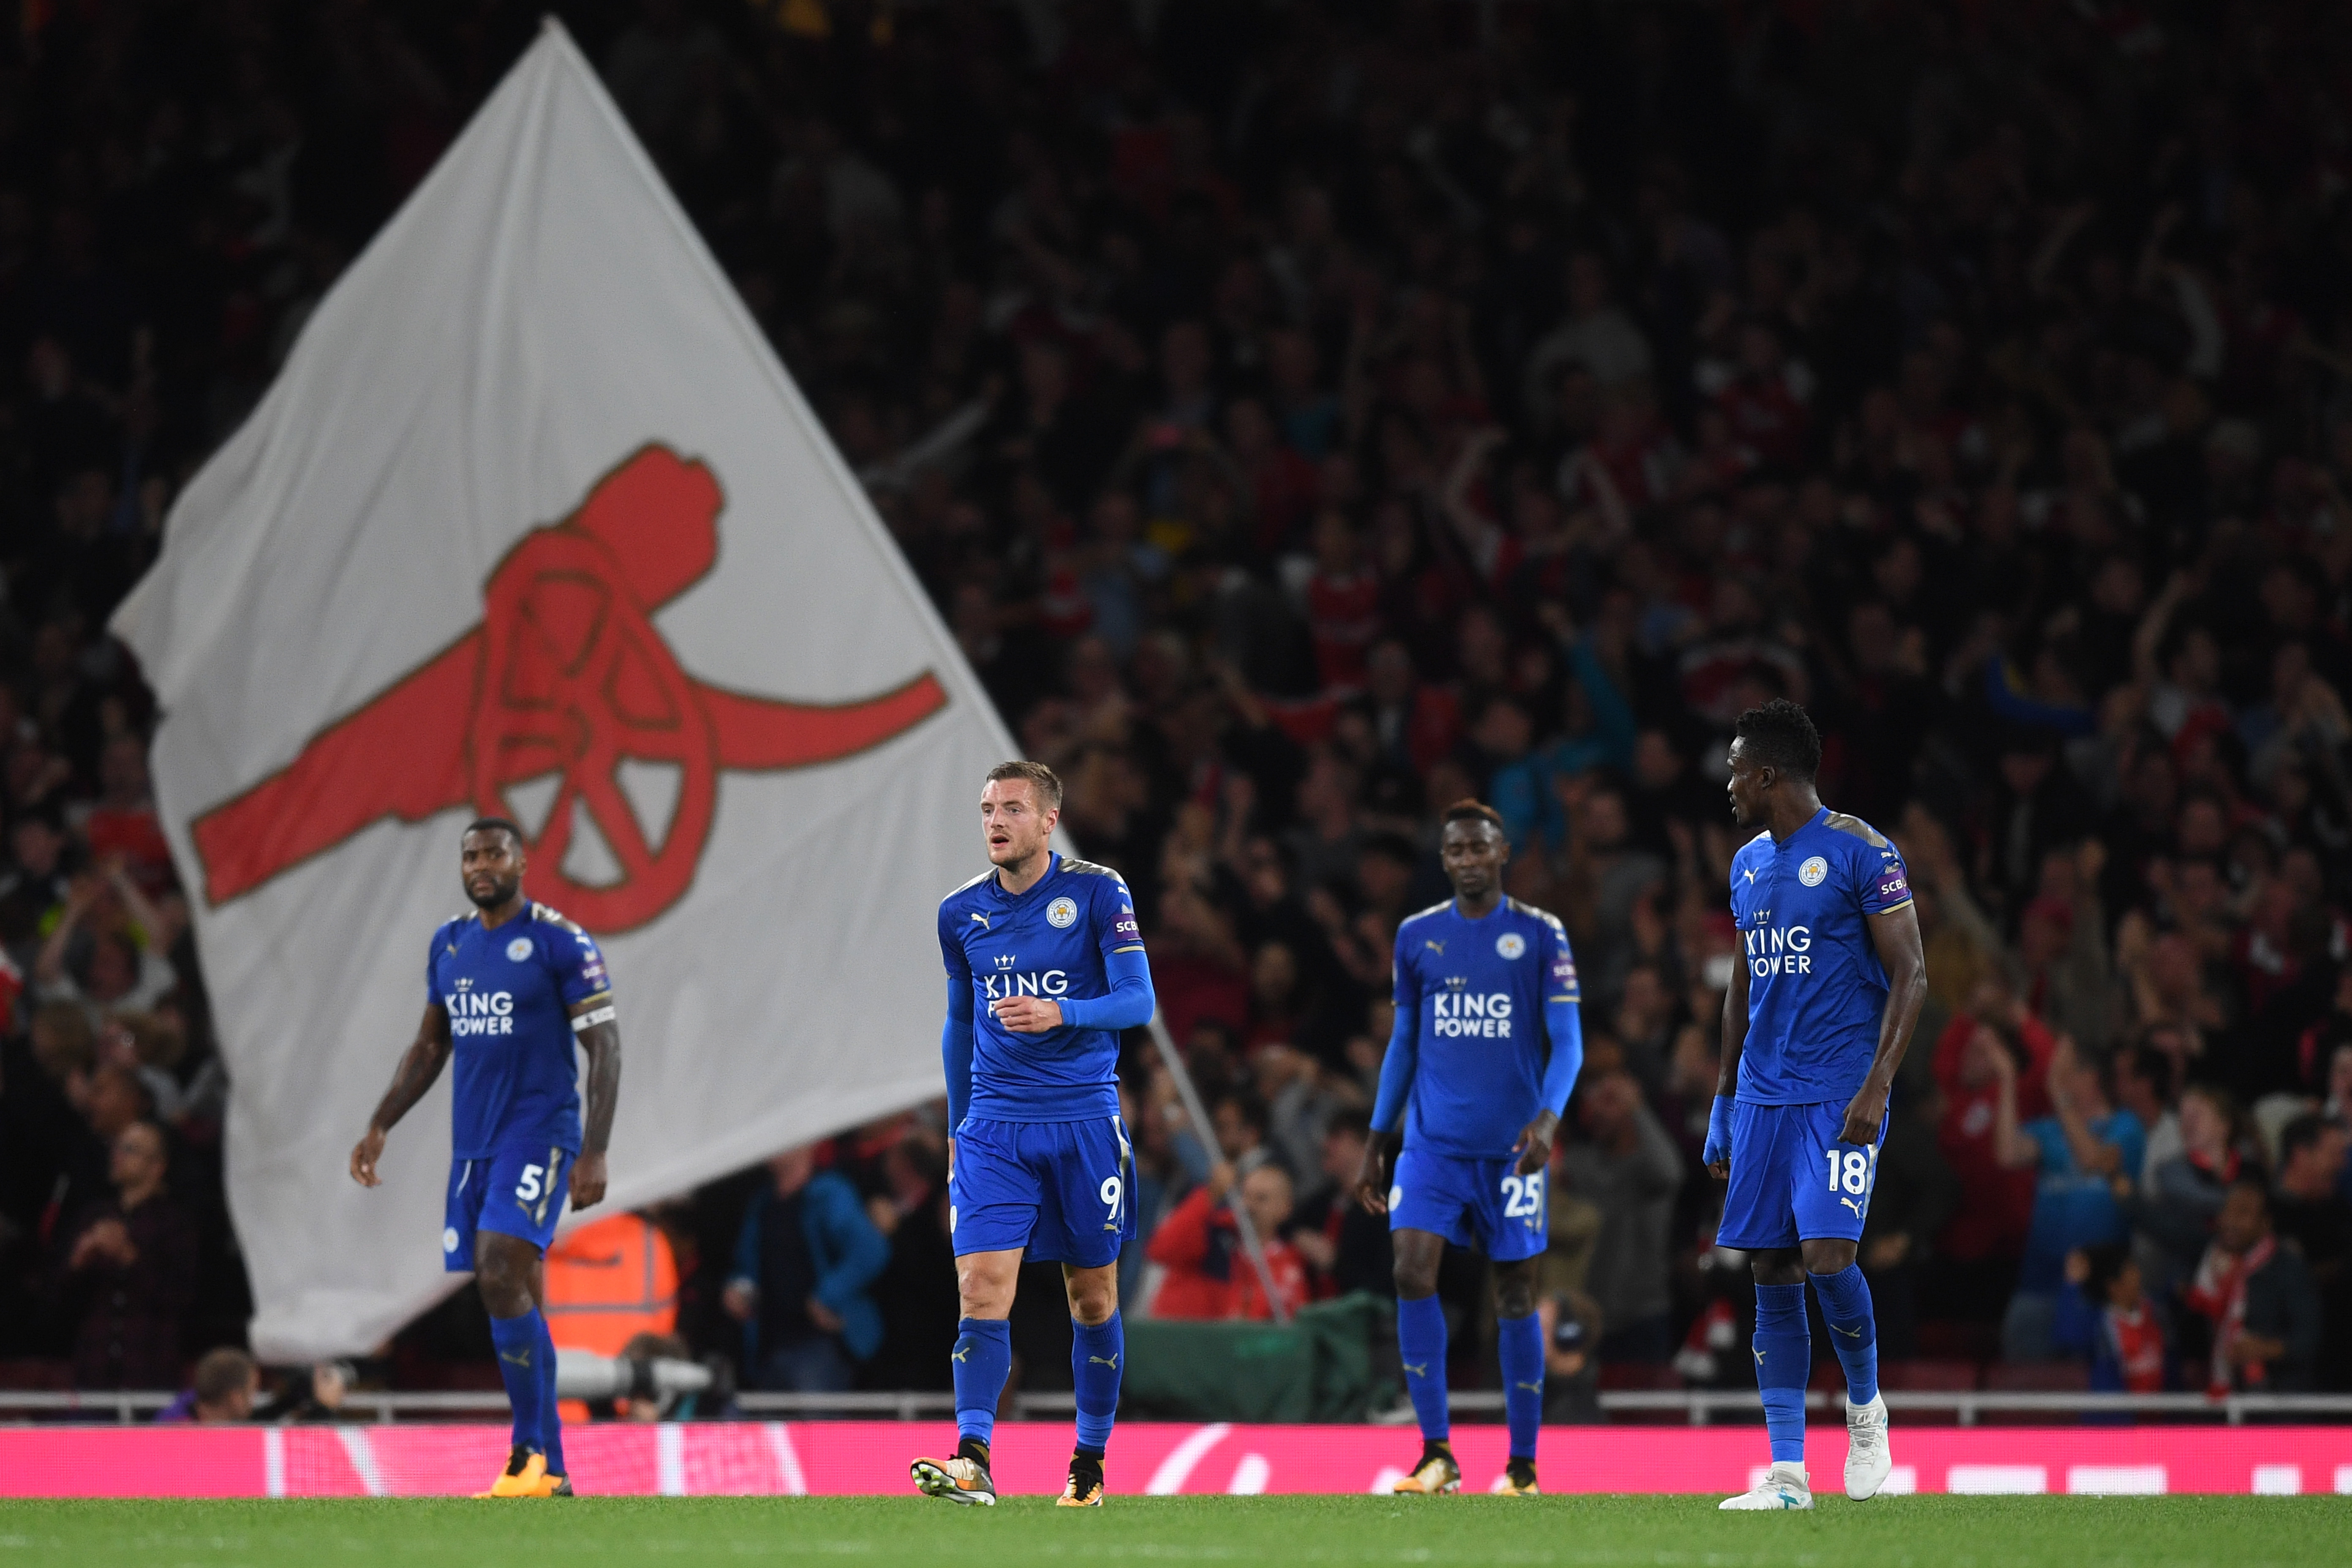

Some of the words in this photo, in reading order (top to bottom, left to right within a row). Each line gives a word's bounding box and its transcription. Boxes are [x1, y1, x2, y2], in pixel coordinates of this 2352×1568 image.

[1881, 879, 1903, 895] SCB
[1116, 921, 1137, 933] SCB
[1745, 926, 1811, 956] KING
[984, 969, 1068, 998] KING
[445, 991, 514, 1016] KING
[1435, 993, 1512, 1018] KING
[1435, 1018, 1511, 1038] POWER
[515, 1163, 544, 1201] 5
[1826, 1150, 1867, 1195] 18
[1100, 1176, 1121, 1220] 9
[1500, 1174, 1540, 1217] 25
